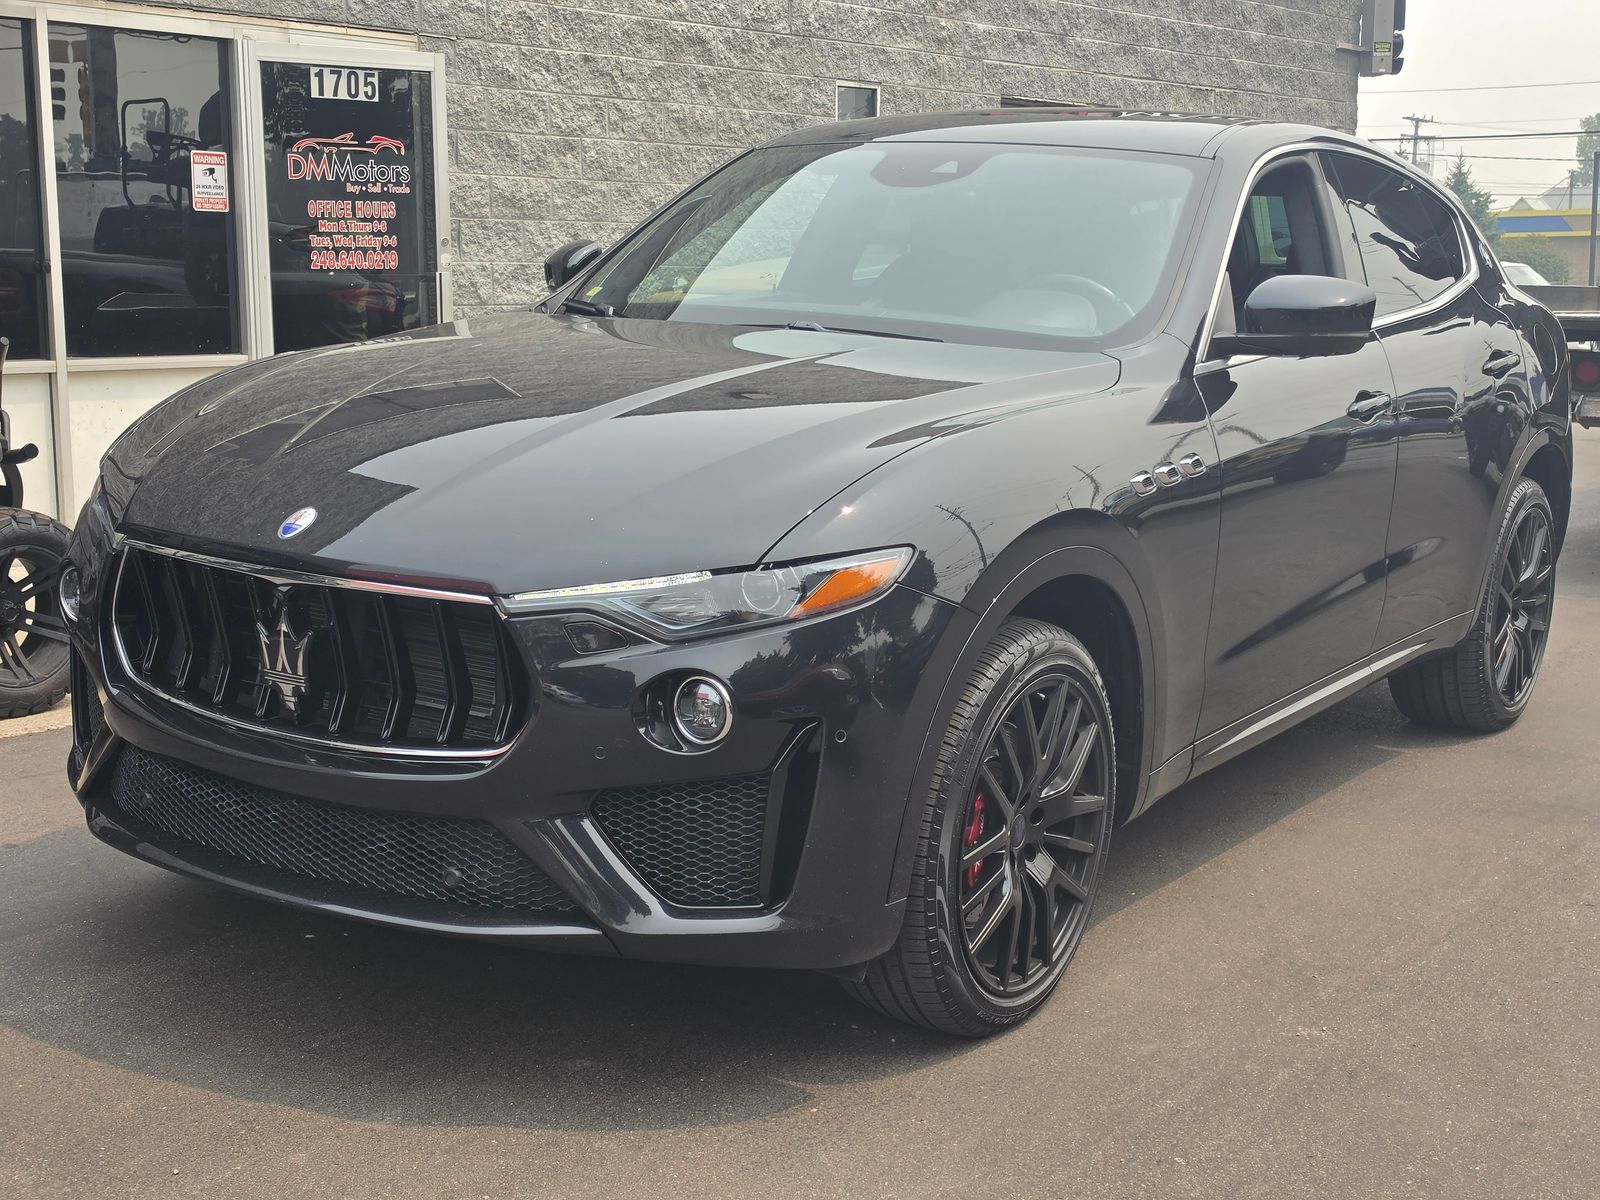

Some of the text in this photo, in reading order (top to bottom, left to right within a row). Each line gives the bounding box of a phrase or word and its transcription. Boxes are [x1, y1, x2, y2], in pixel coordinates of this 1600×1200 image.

[313, 68, 377, 100] 1705
[193, 154, 225, 165] WARNING
[346, 183, 410, 194] Buy Sell Trade
[307, 199, 396, 219] OFFICE HOURS
[318, 220, 387, 233] Mon & Thurs 9-8
[309, 234, 397, 250] Tues, Wed, Friday 9-6
[310, 250, 399, 270] 248.640.0219
